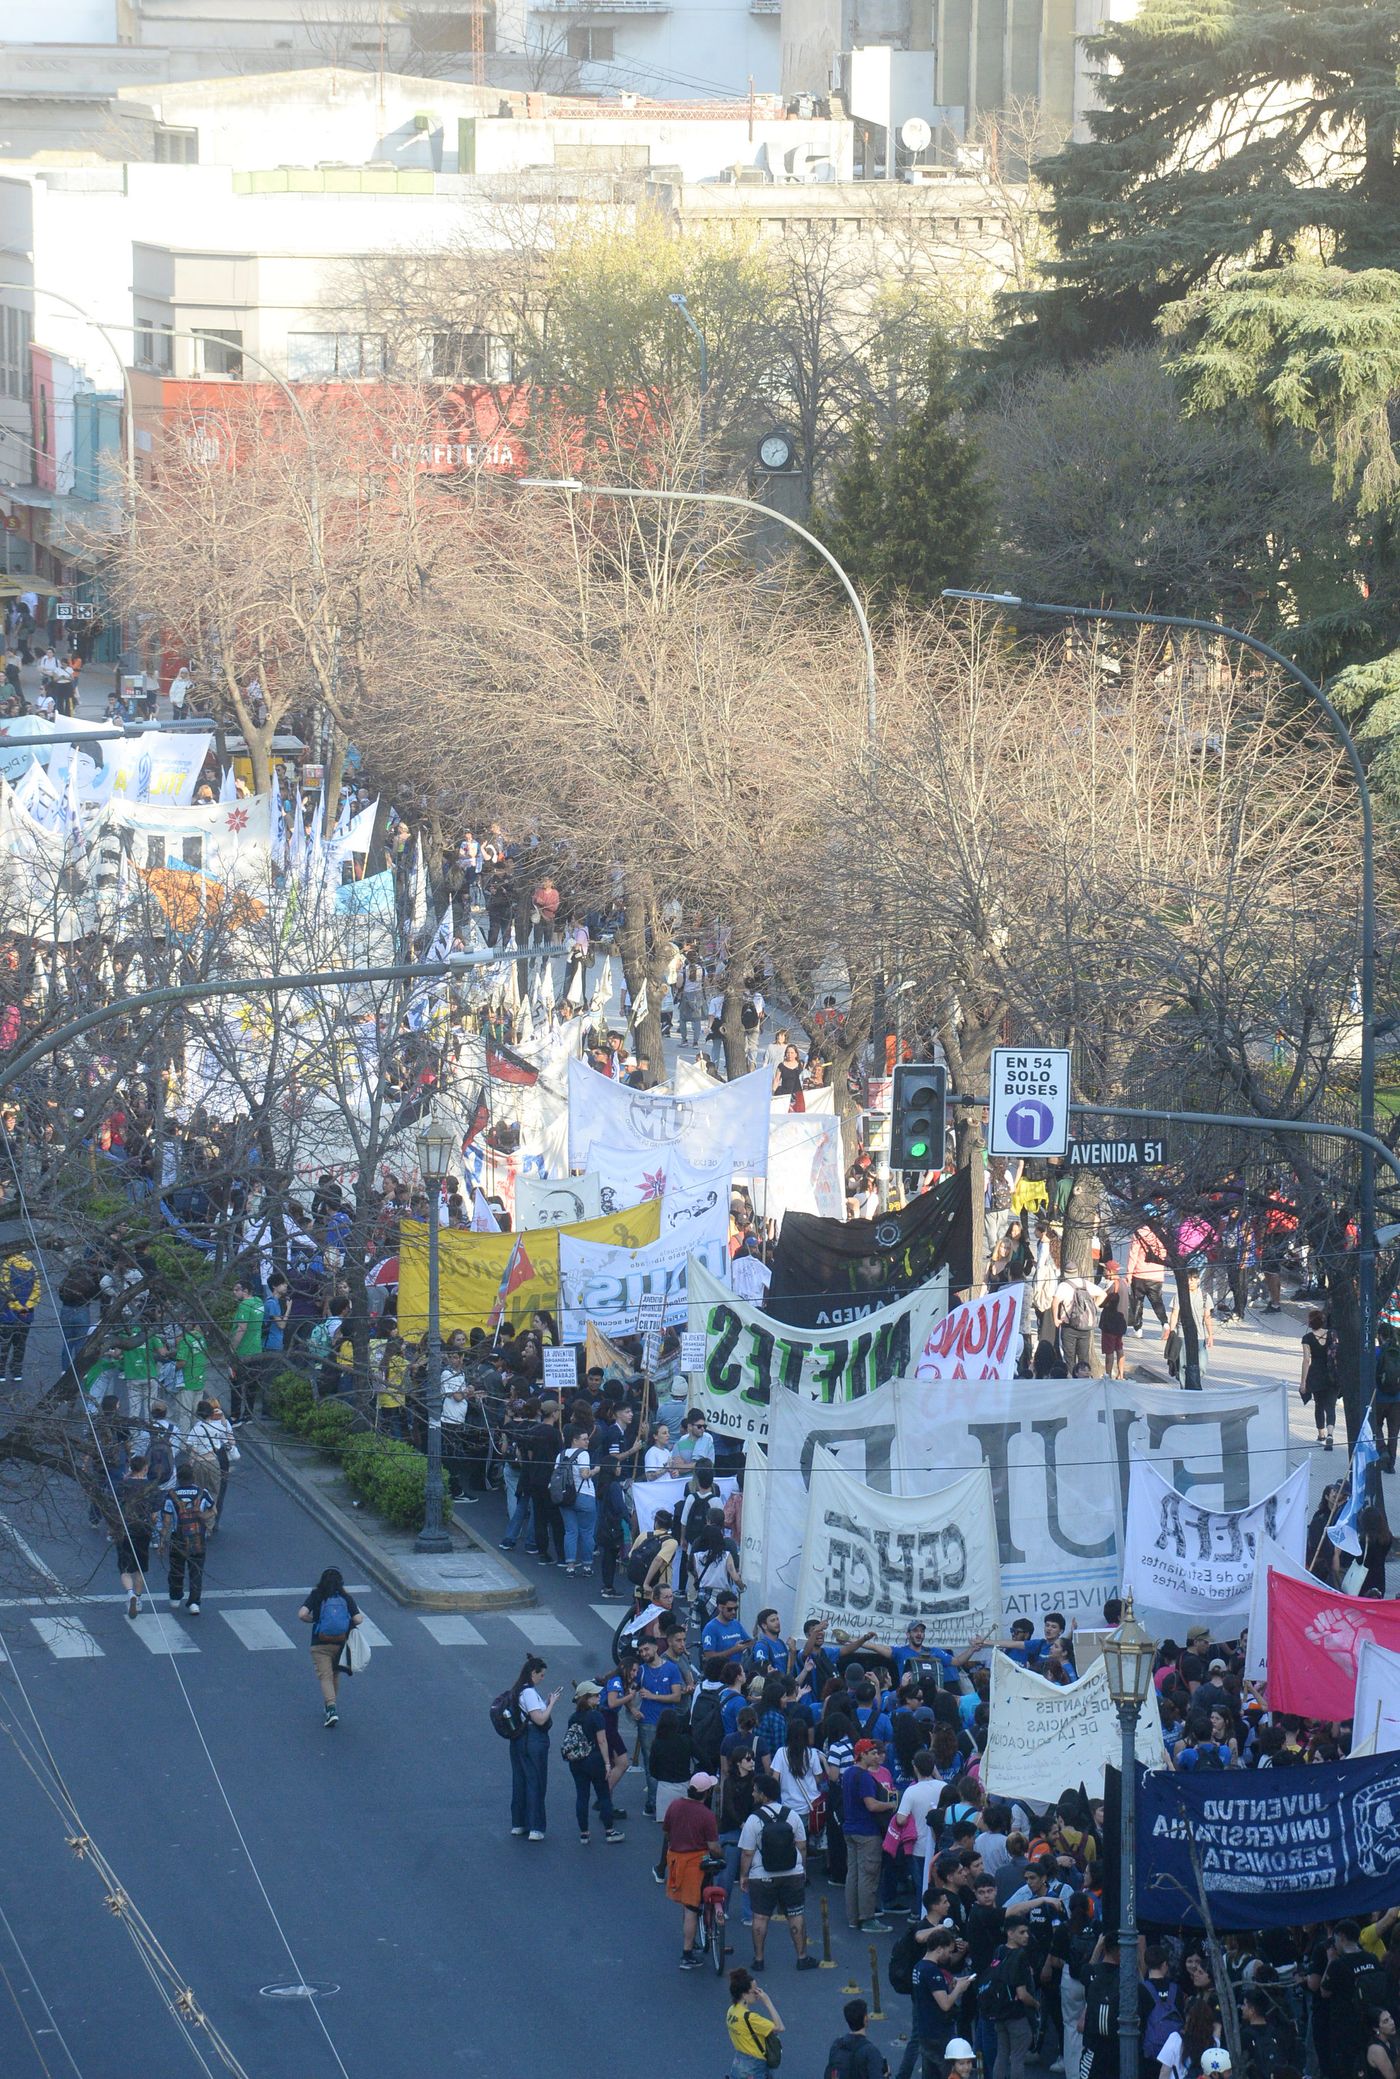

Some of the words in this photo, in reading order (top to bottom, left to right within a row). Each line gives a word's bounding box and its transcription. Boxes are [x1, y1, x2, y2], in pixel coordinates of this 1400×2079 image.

[59, 606, 72, 615] 53
[1006, 1057, 1027, 1069] EN
[1034, 1057, 1052, 1069] 54
[1007, 1070, 1050, 1082] SOLO
[1004, 1084, 1058, 1096] BUSES
[1070, 1142, 1138, 1165] AVENIDA
[1144, 1141, 1163, 1163] 51
